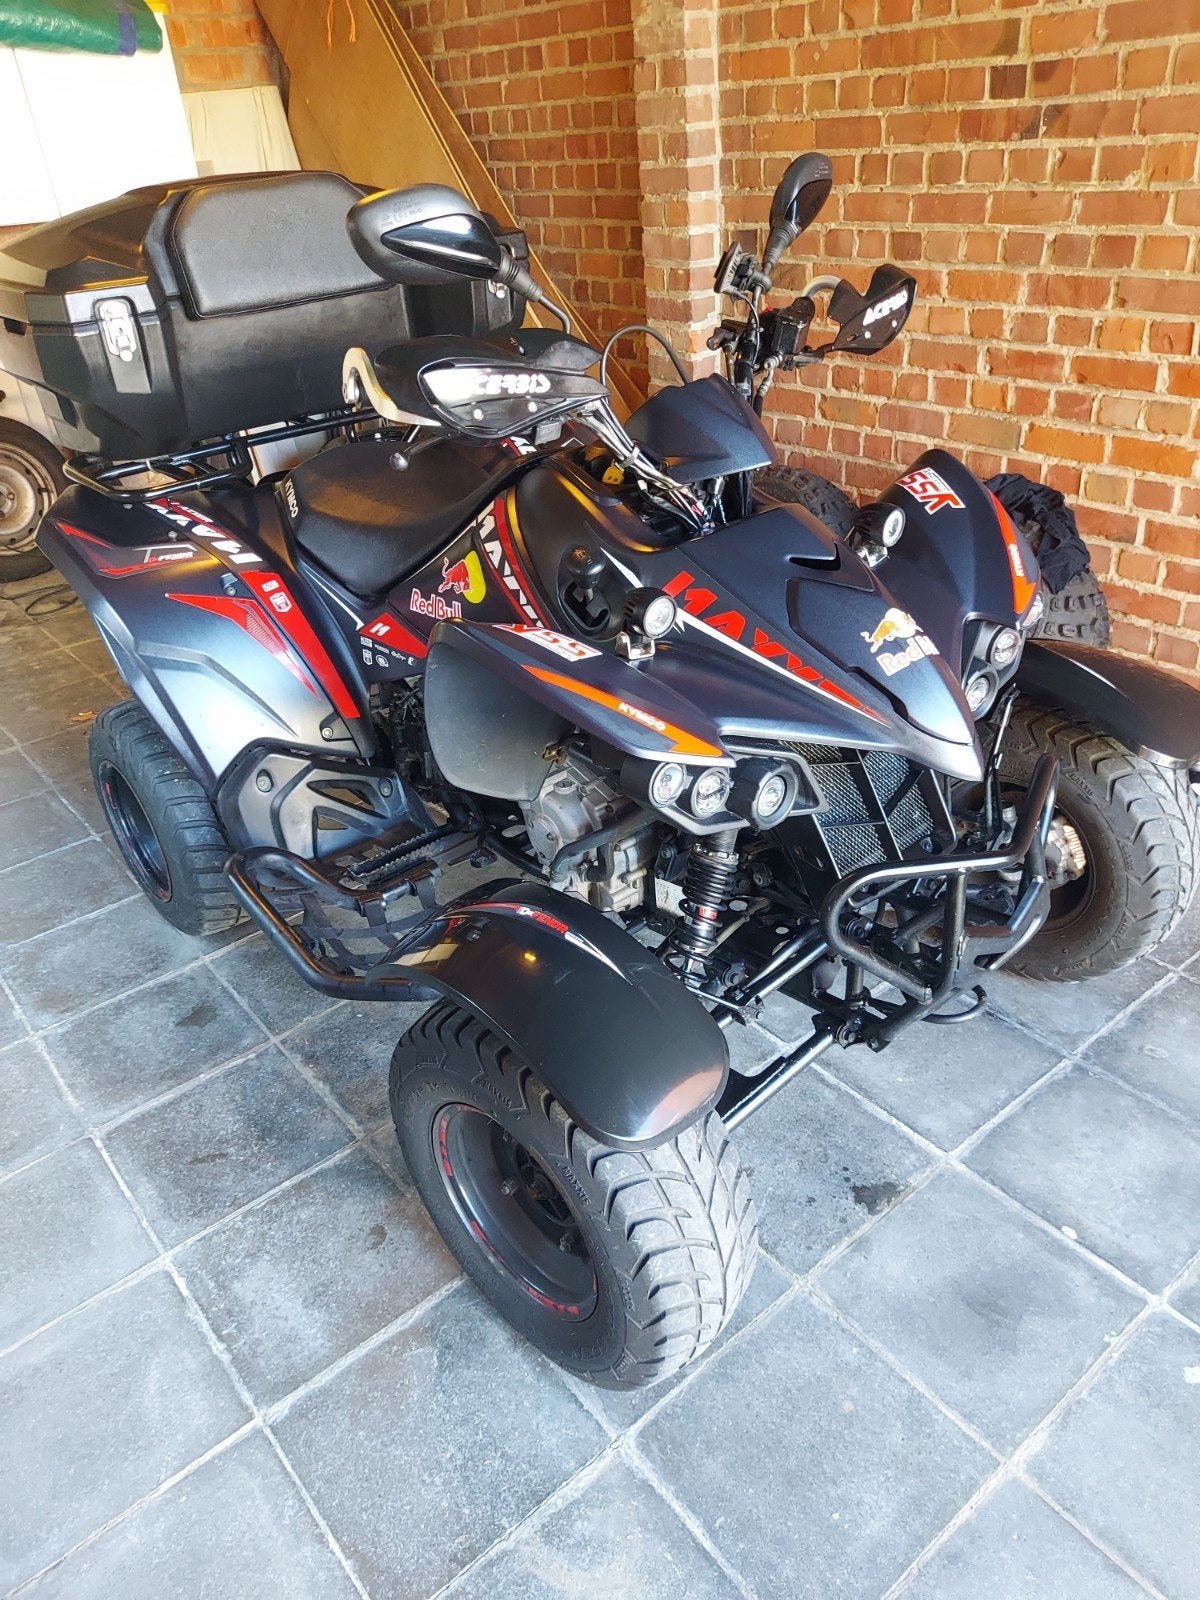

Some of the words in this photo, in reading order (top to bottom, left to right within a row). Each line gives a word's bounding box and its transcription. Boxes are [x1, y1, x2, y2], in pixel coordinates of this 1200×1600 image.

[467, 373, 552, 395] CERBIS
[284, 478, 299, 518] KYMCO
[410, 588, 435, 618] Red
[436, 596, 462, 620] Bull
[876, 636, 926, 677] Red
[618, 702, 666, 731] KYMCO
